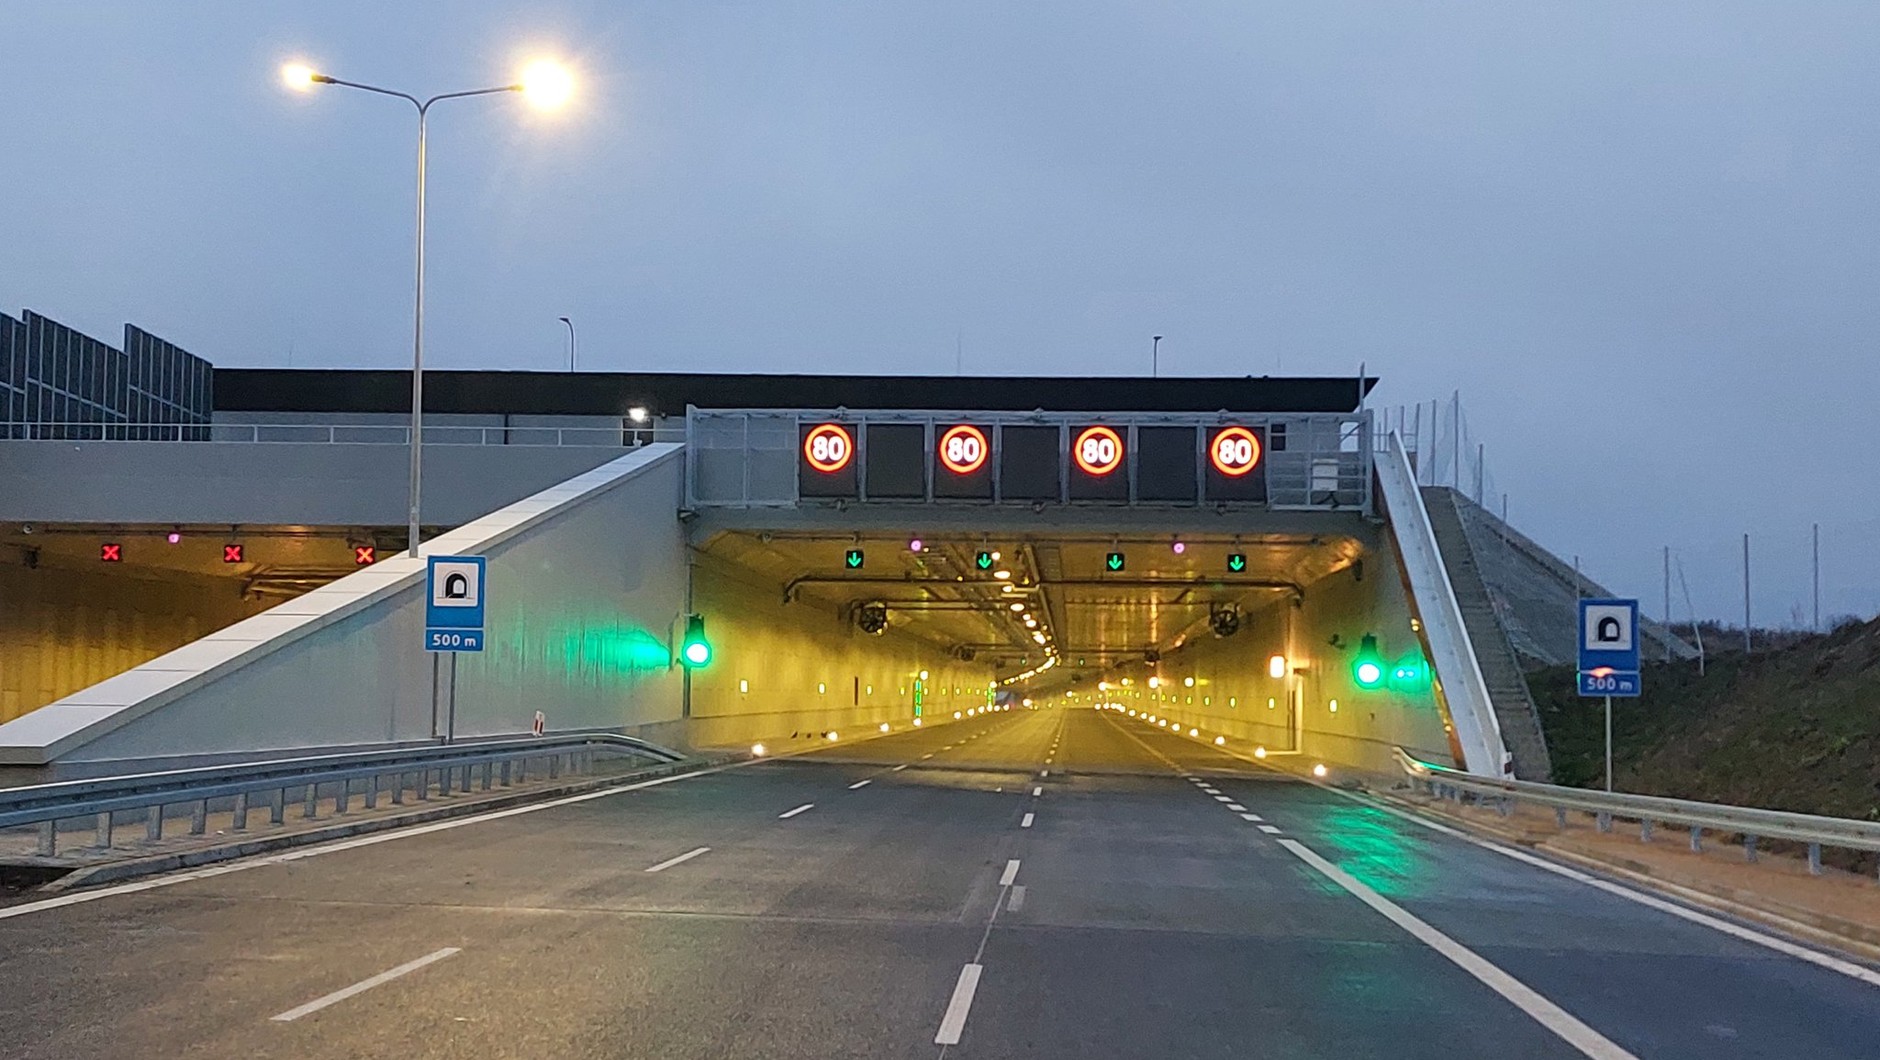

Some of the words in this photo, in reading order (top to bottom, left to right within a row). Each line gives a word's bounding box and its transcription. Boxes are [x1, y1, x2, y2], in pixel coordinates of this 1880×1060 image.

[812, 436, 845, 461] 80
[947, 437, 980, 462] 80
[1082, 438, 1115, 464] 80
[1219, 439, 1252, 464] 80
[432, 633, 460, 646] 500
[464, 637, 476, 647] m
[1587, 676, 1616, 690] 500
[1620, 681, 1633, 691] m
